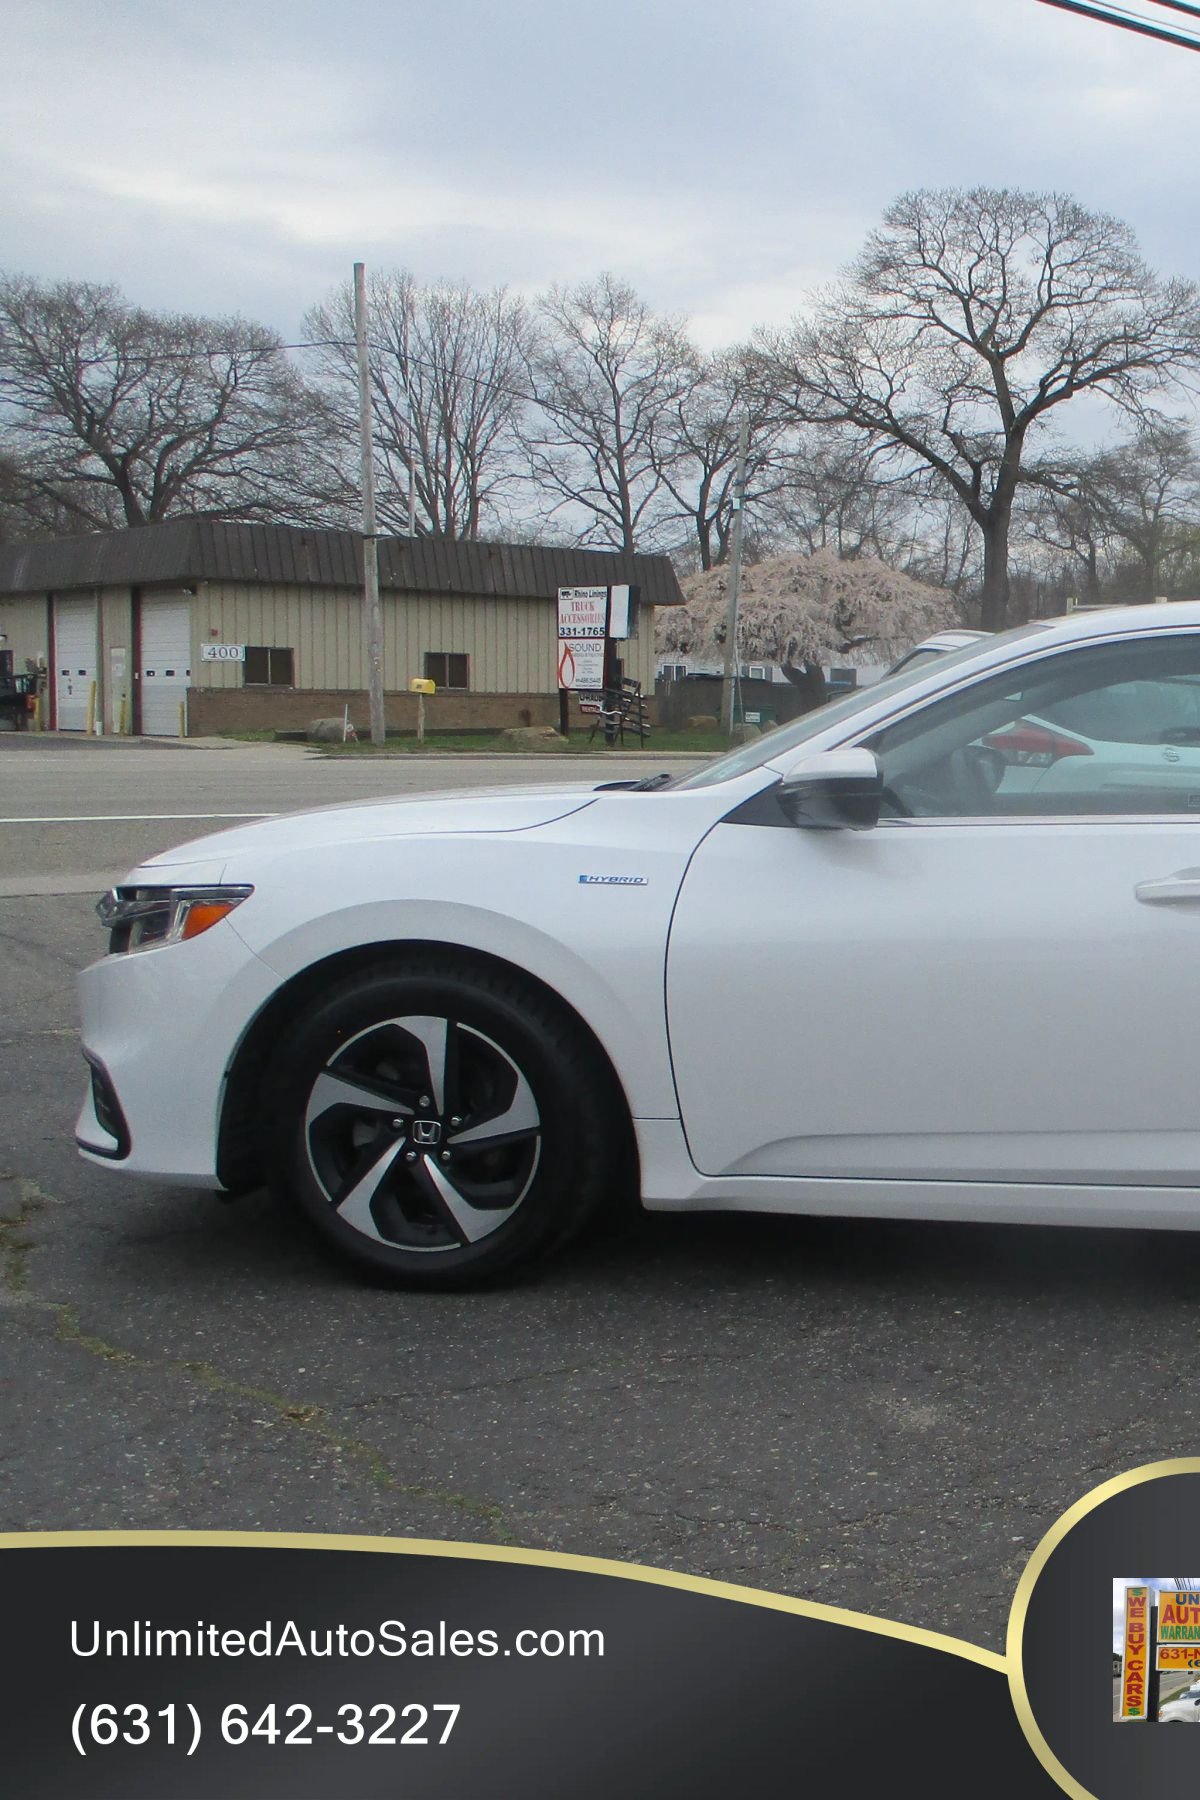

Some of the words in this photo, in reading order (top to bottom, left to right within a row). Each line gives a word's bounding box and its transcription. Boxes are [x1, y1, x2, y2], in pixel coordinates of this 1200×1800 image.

[571, 601, 595, 611] TRUCK
[560, 613, 605, 625] ACCESSORIES
[560, 627, 605, 636] 331-1765
[569, 643, 602, 652] SOUND
[208, 647, 238, 659] 400
